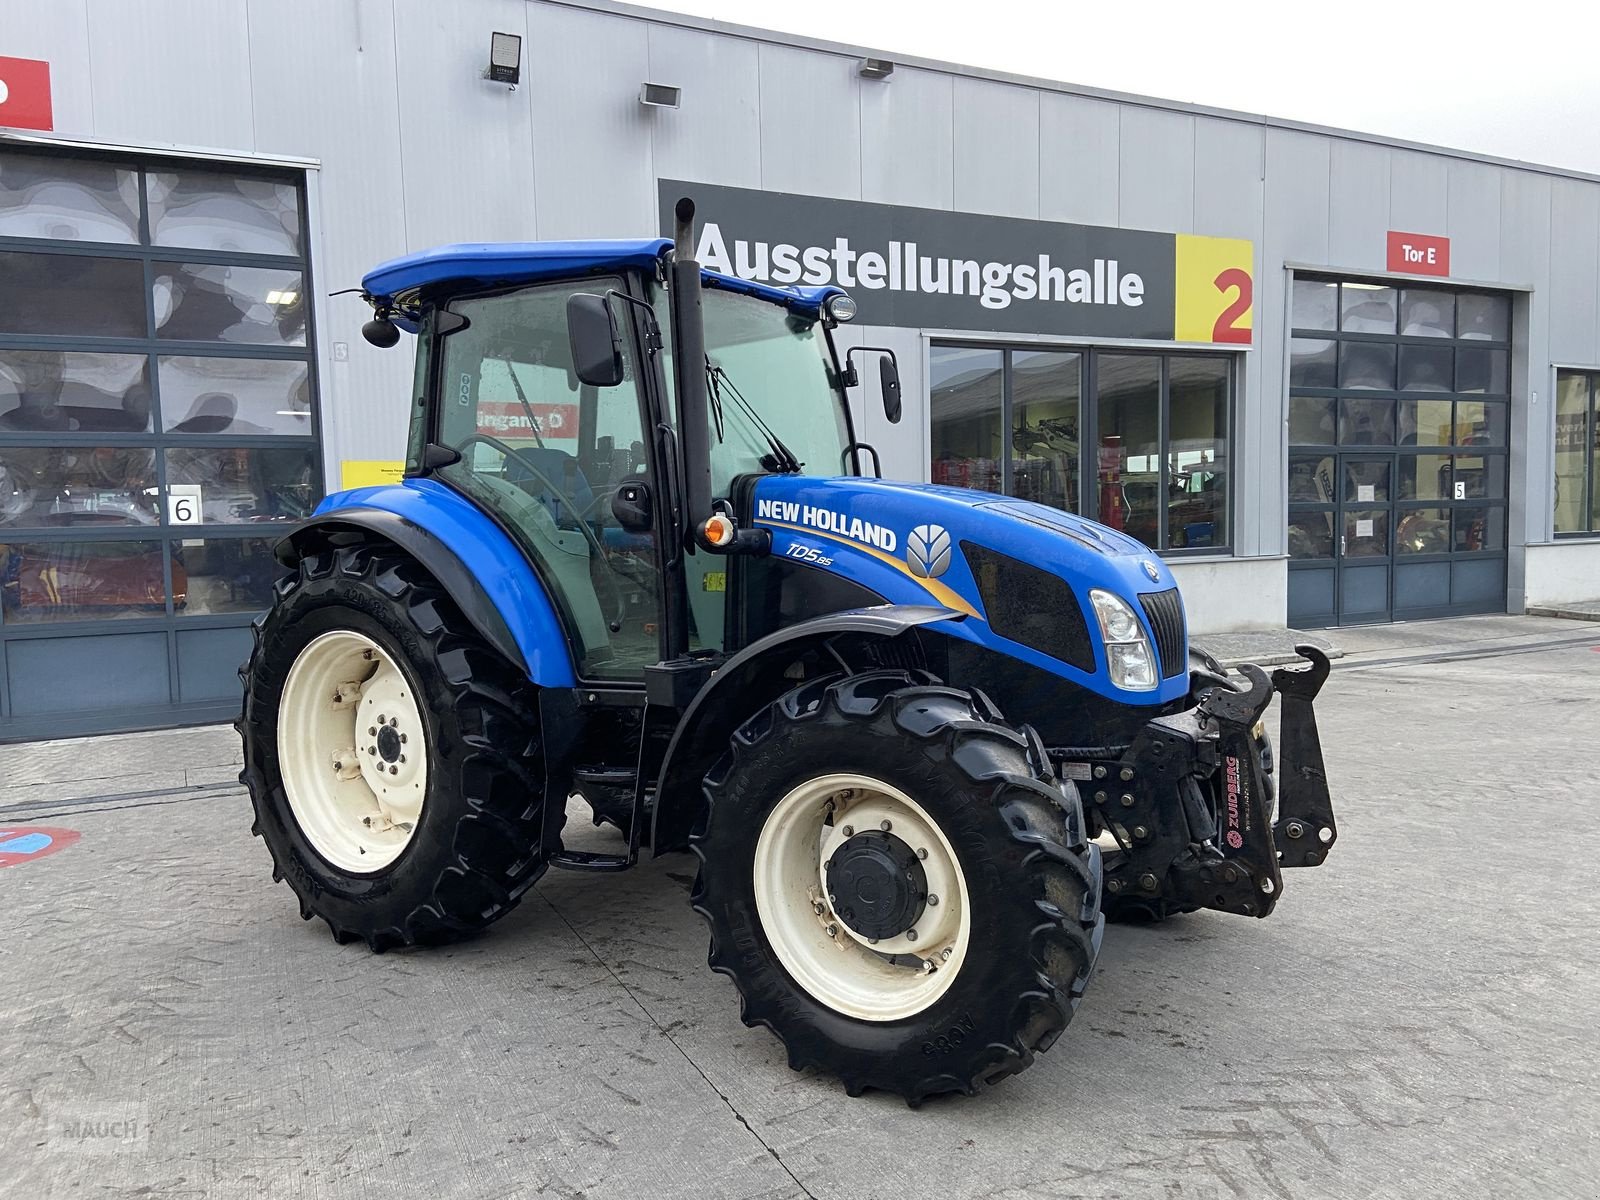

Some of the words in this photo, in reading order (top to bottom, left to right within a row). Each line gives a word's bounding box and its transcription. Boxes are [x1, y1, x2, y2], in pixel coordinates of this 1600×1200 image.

[694, 222, 1145, 310] Ausstellungshalle
[1402, 244, 1425, 263] Tor
[1427, 247, 1436, 265] E
[1211, 267, 1253, 345] 2
[1456, 484, 1463, 498] 5
[175, 499, 192, 522] 6
[758, 499, 800, 523] NEW
[803, 505, 897, 552] HOLLAND
[785, 543, 834, 566] TD5.85
[1226, 756, 1240, 829] ZUIDBERG
